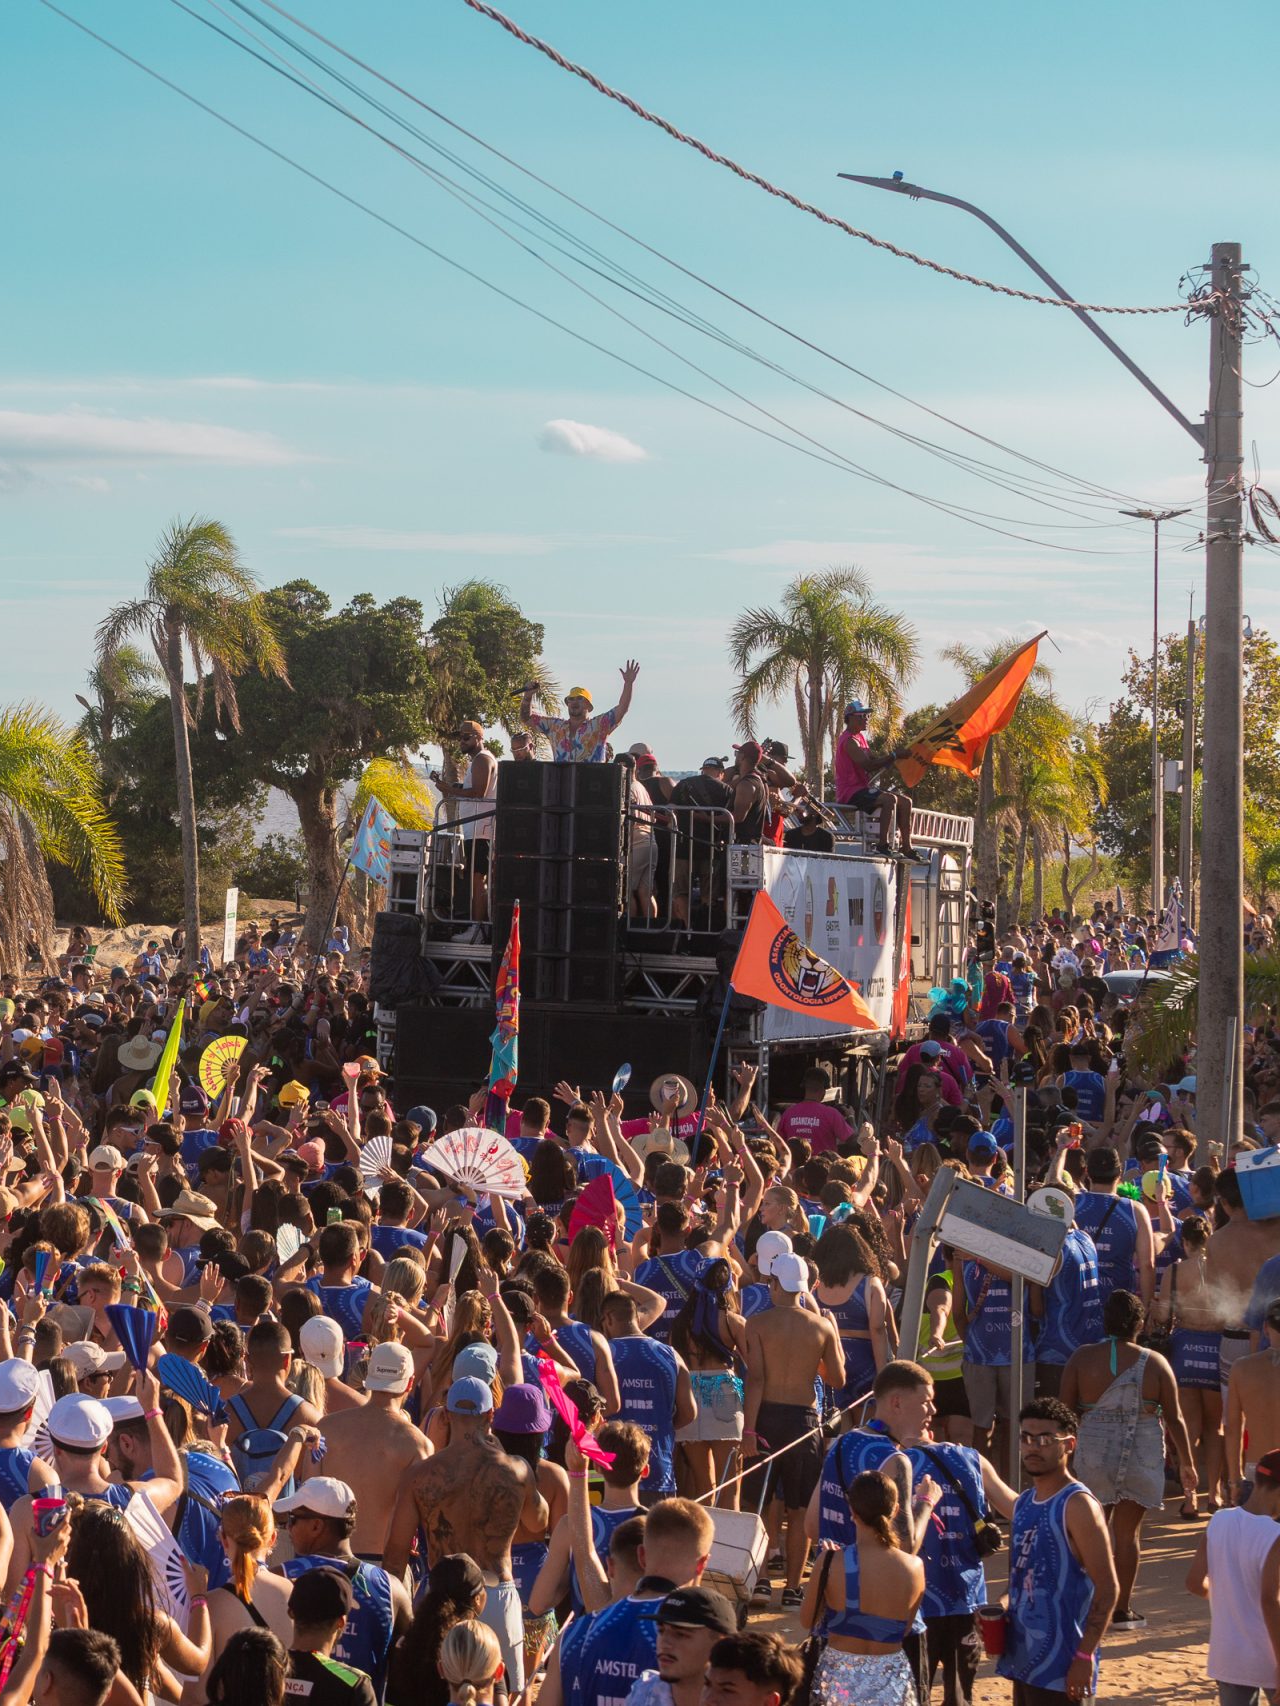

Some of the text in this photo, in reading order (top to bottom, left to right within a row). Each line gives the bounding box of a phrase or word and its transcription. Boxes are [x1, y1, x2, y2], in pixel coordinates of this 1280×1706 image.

[773, 971, 848, 1005] ODONTOLOGIA UFPEL
[1084, 1225, 1114, 1235] AMTEL
[1183, 1344, 1219, 1354] AMSTEL
[376, 1366, 398, 1374] Supreme
[622, 1378, 655, 1389] AMSTEL
[594, 1658, 640, 1679] AMSTEL
